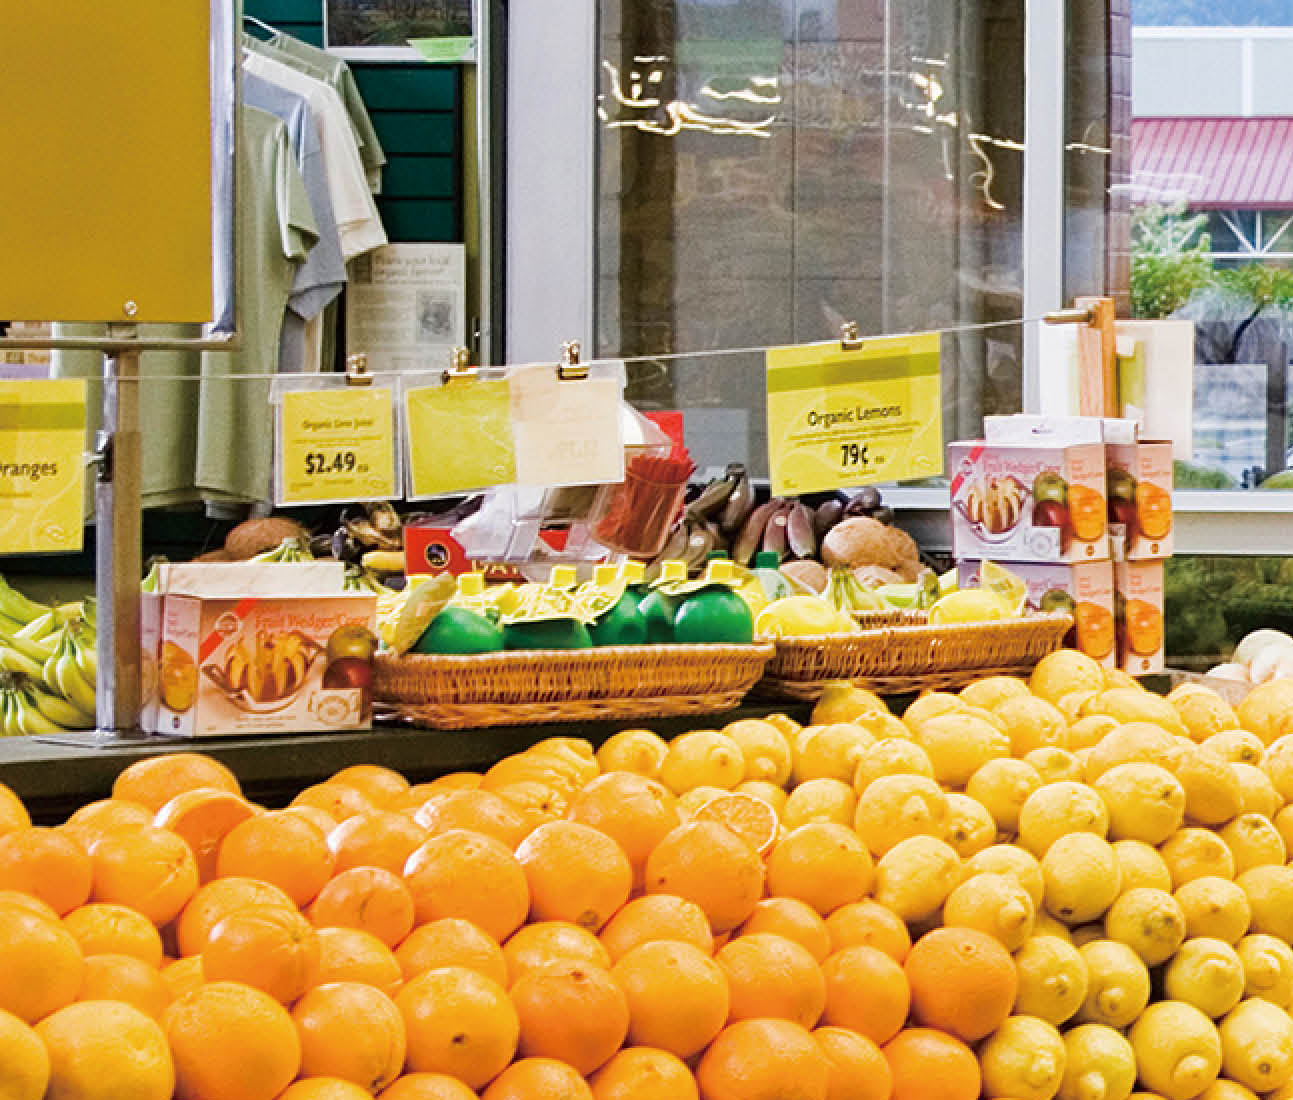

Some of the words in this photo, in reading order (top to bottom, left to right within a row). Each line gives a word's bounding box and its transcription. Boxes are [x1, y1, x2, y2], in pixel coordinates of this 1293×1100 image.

[808, 409, 854, 430] Organic
[856, 404, 903, 421] Lemons
[304, 451, 356, 475] $2.49
[840, 443, 869, 467] 79¢
[0, 462, 58, 481] ranges
